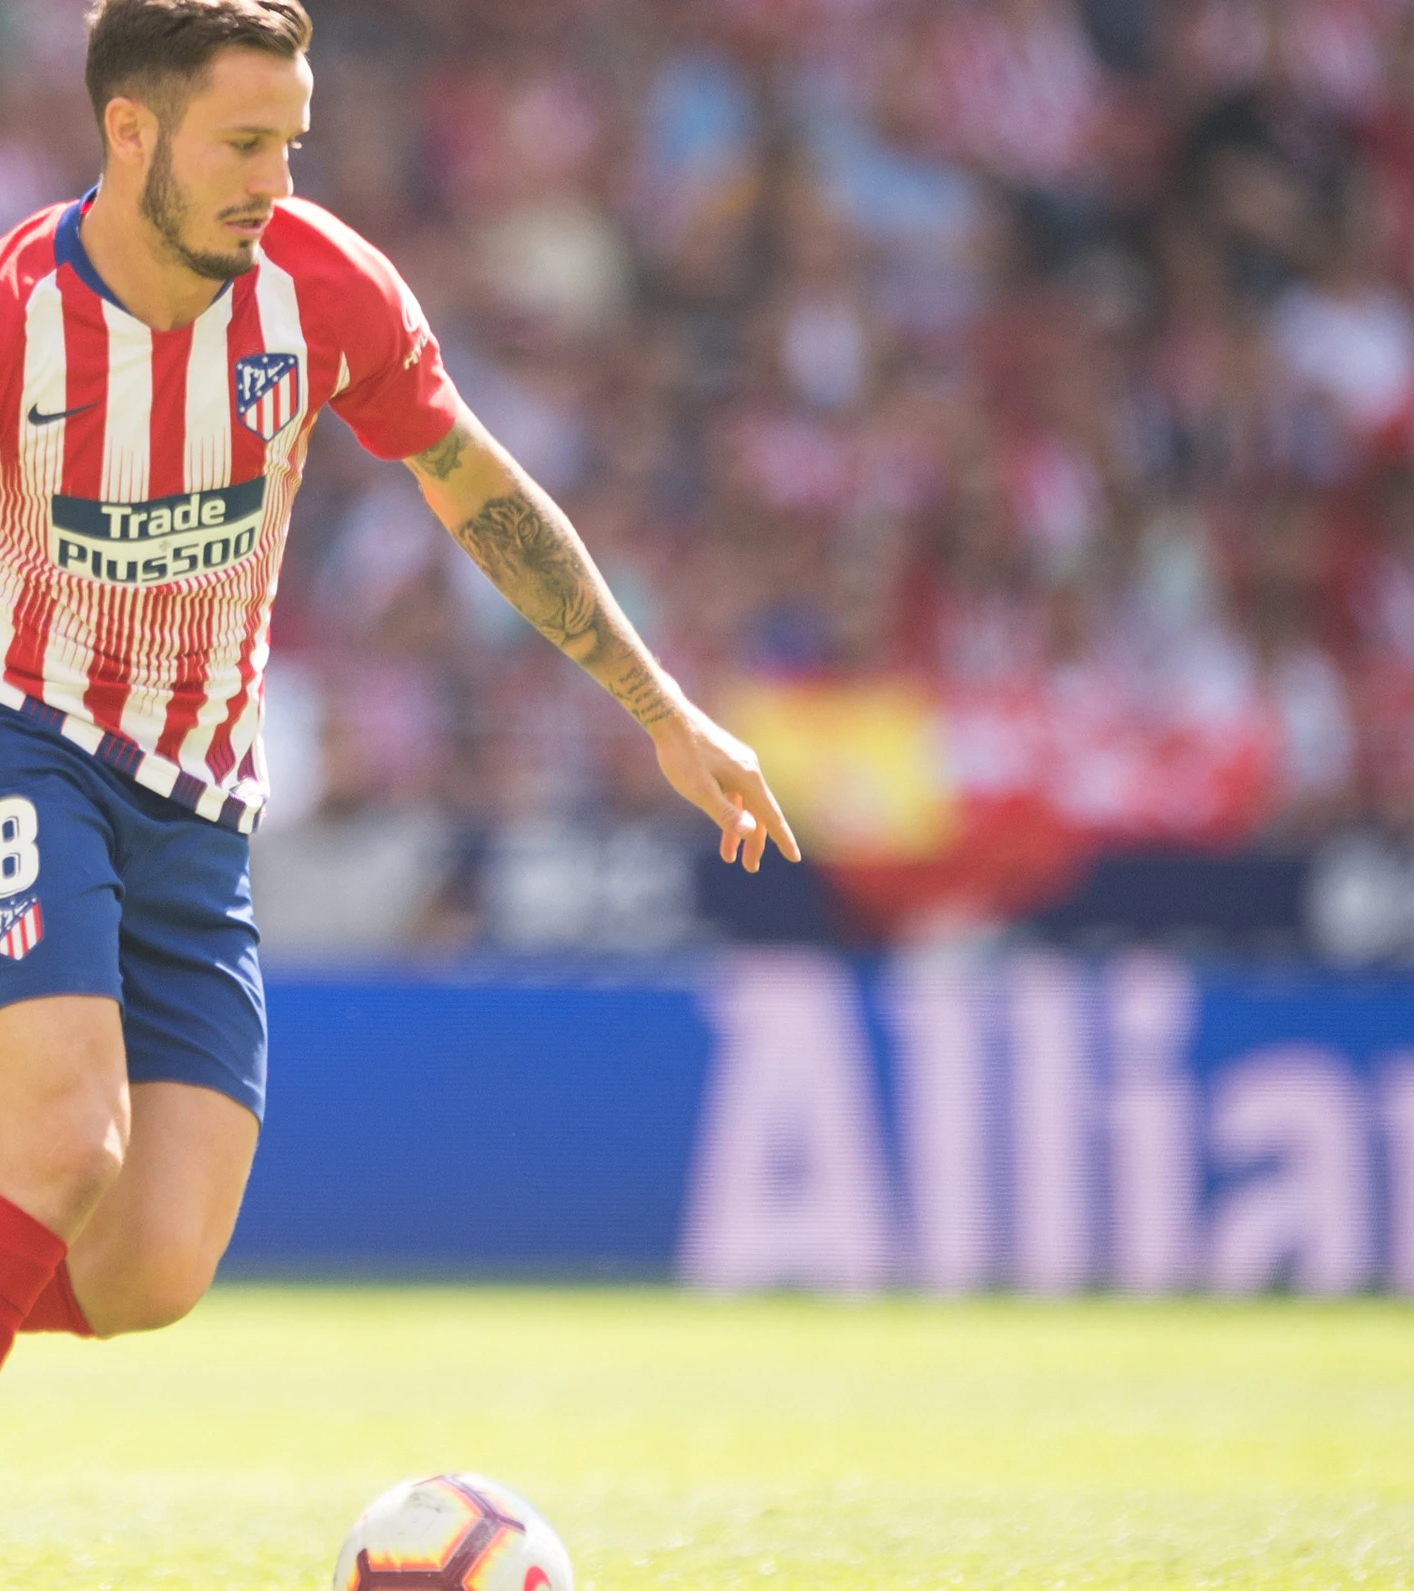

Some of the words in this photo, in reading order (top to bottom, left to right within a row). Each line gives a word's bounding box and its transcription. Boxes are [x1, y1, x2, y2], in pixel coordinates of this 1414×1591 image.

[100, 493, 227, 540] Trade
[58, 526, 256, 584] Plus500
[678, 945, 1414, 1295] Allia
